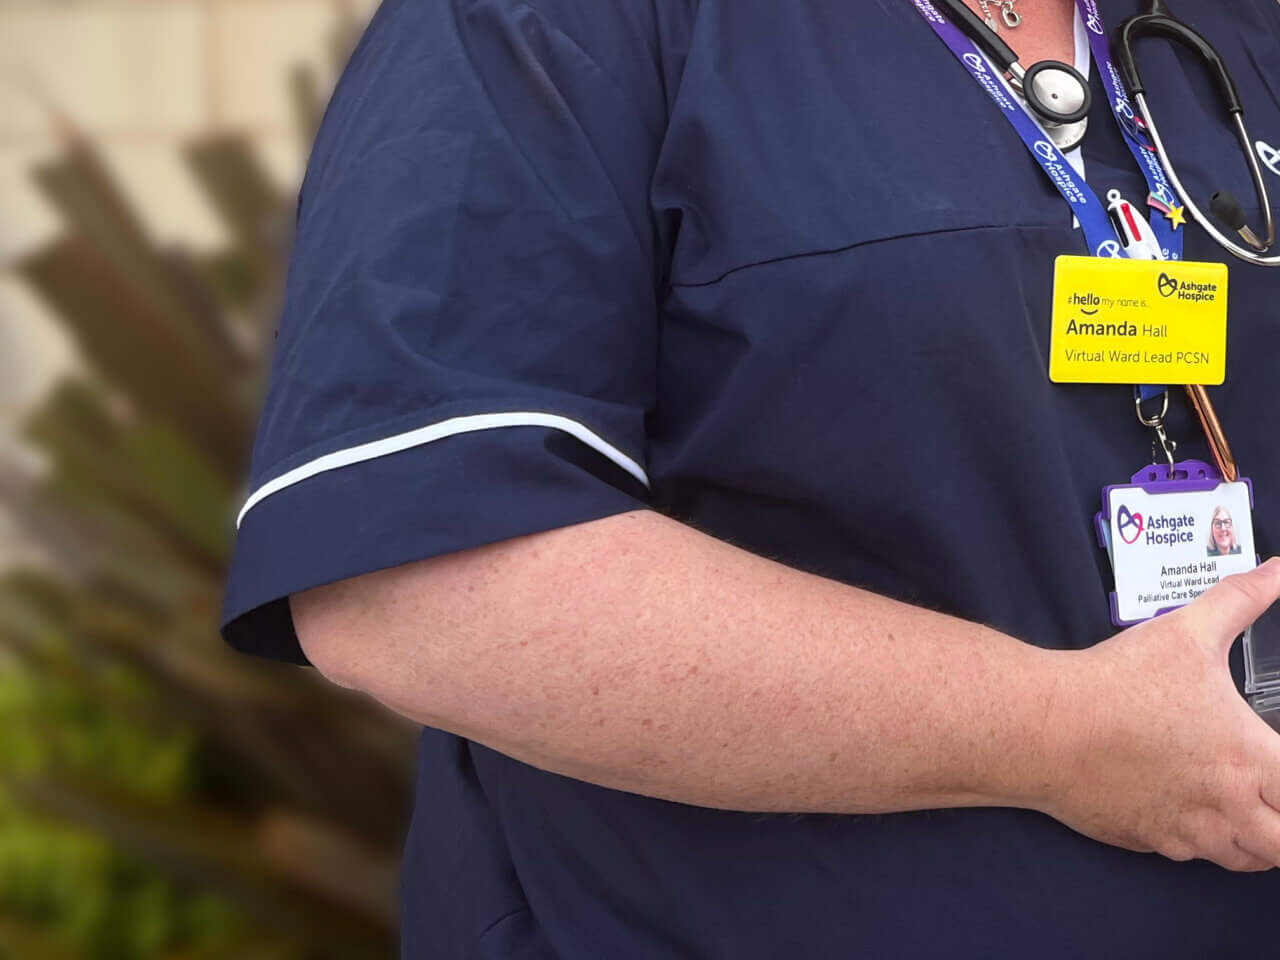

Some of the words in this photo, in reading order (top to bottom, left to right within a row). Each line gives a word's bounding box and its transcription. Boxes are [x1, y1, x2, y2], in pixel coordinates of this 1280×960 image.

[1045, 162, 1078, 203] Hospice
[1054, 163, 1087, 204] Ashgate
[1179, 281, 1217, 292] Ashgate
[1178, 291, 1215, 302] Hospice
[1066, 319, 1137, 337] Amanda
[1142, 324, 1168, 337] Hall
[1065, 349, 1105, 362] Virtual
[1109, 350, 1140, 363] Ward
[1144, 351, 1172, 364] Lead
[1176, 352, 1210, 365] PCSN
[1147, 514, 1195, 532] Ashgate
[1146, 530, 1194, 547] Hospice
[1160, 564, 1198, 577] Amanda
[1199, 561, 1217, 573] Hall
[1160, 578, 1183, 590] Virtual
[1184, 577, 1202, 587] Ward
[1203, 575, 1220, 585] Lead
[1137, 592, 1170, 604] Palliative
[1171, 591, 1188, 601] Care
